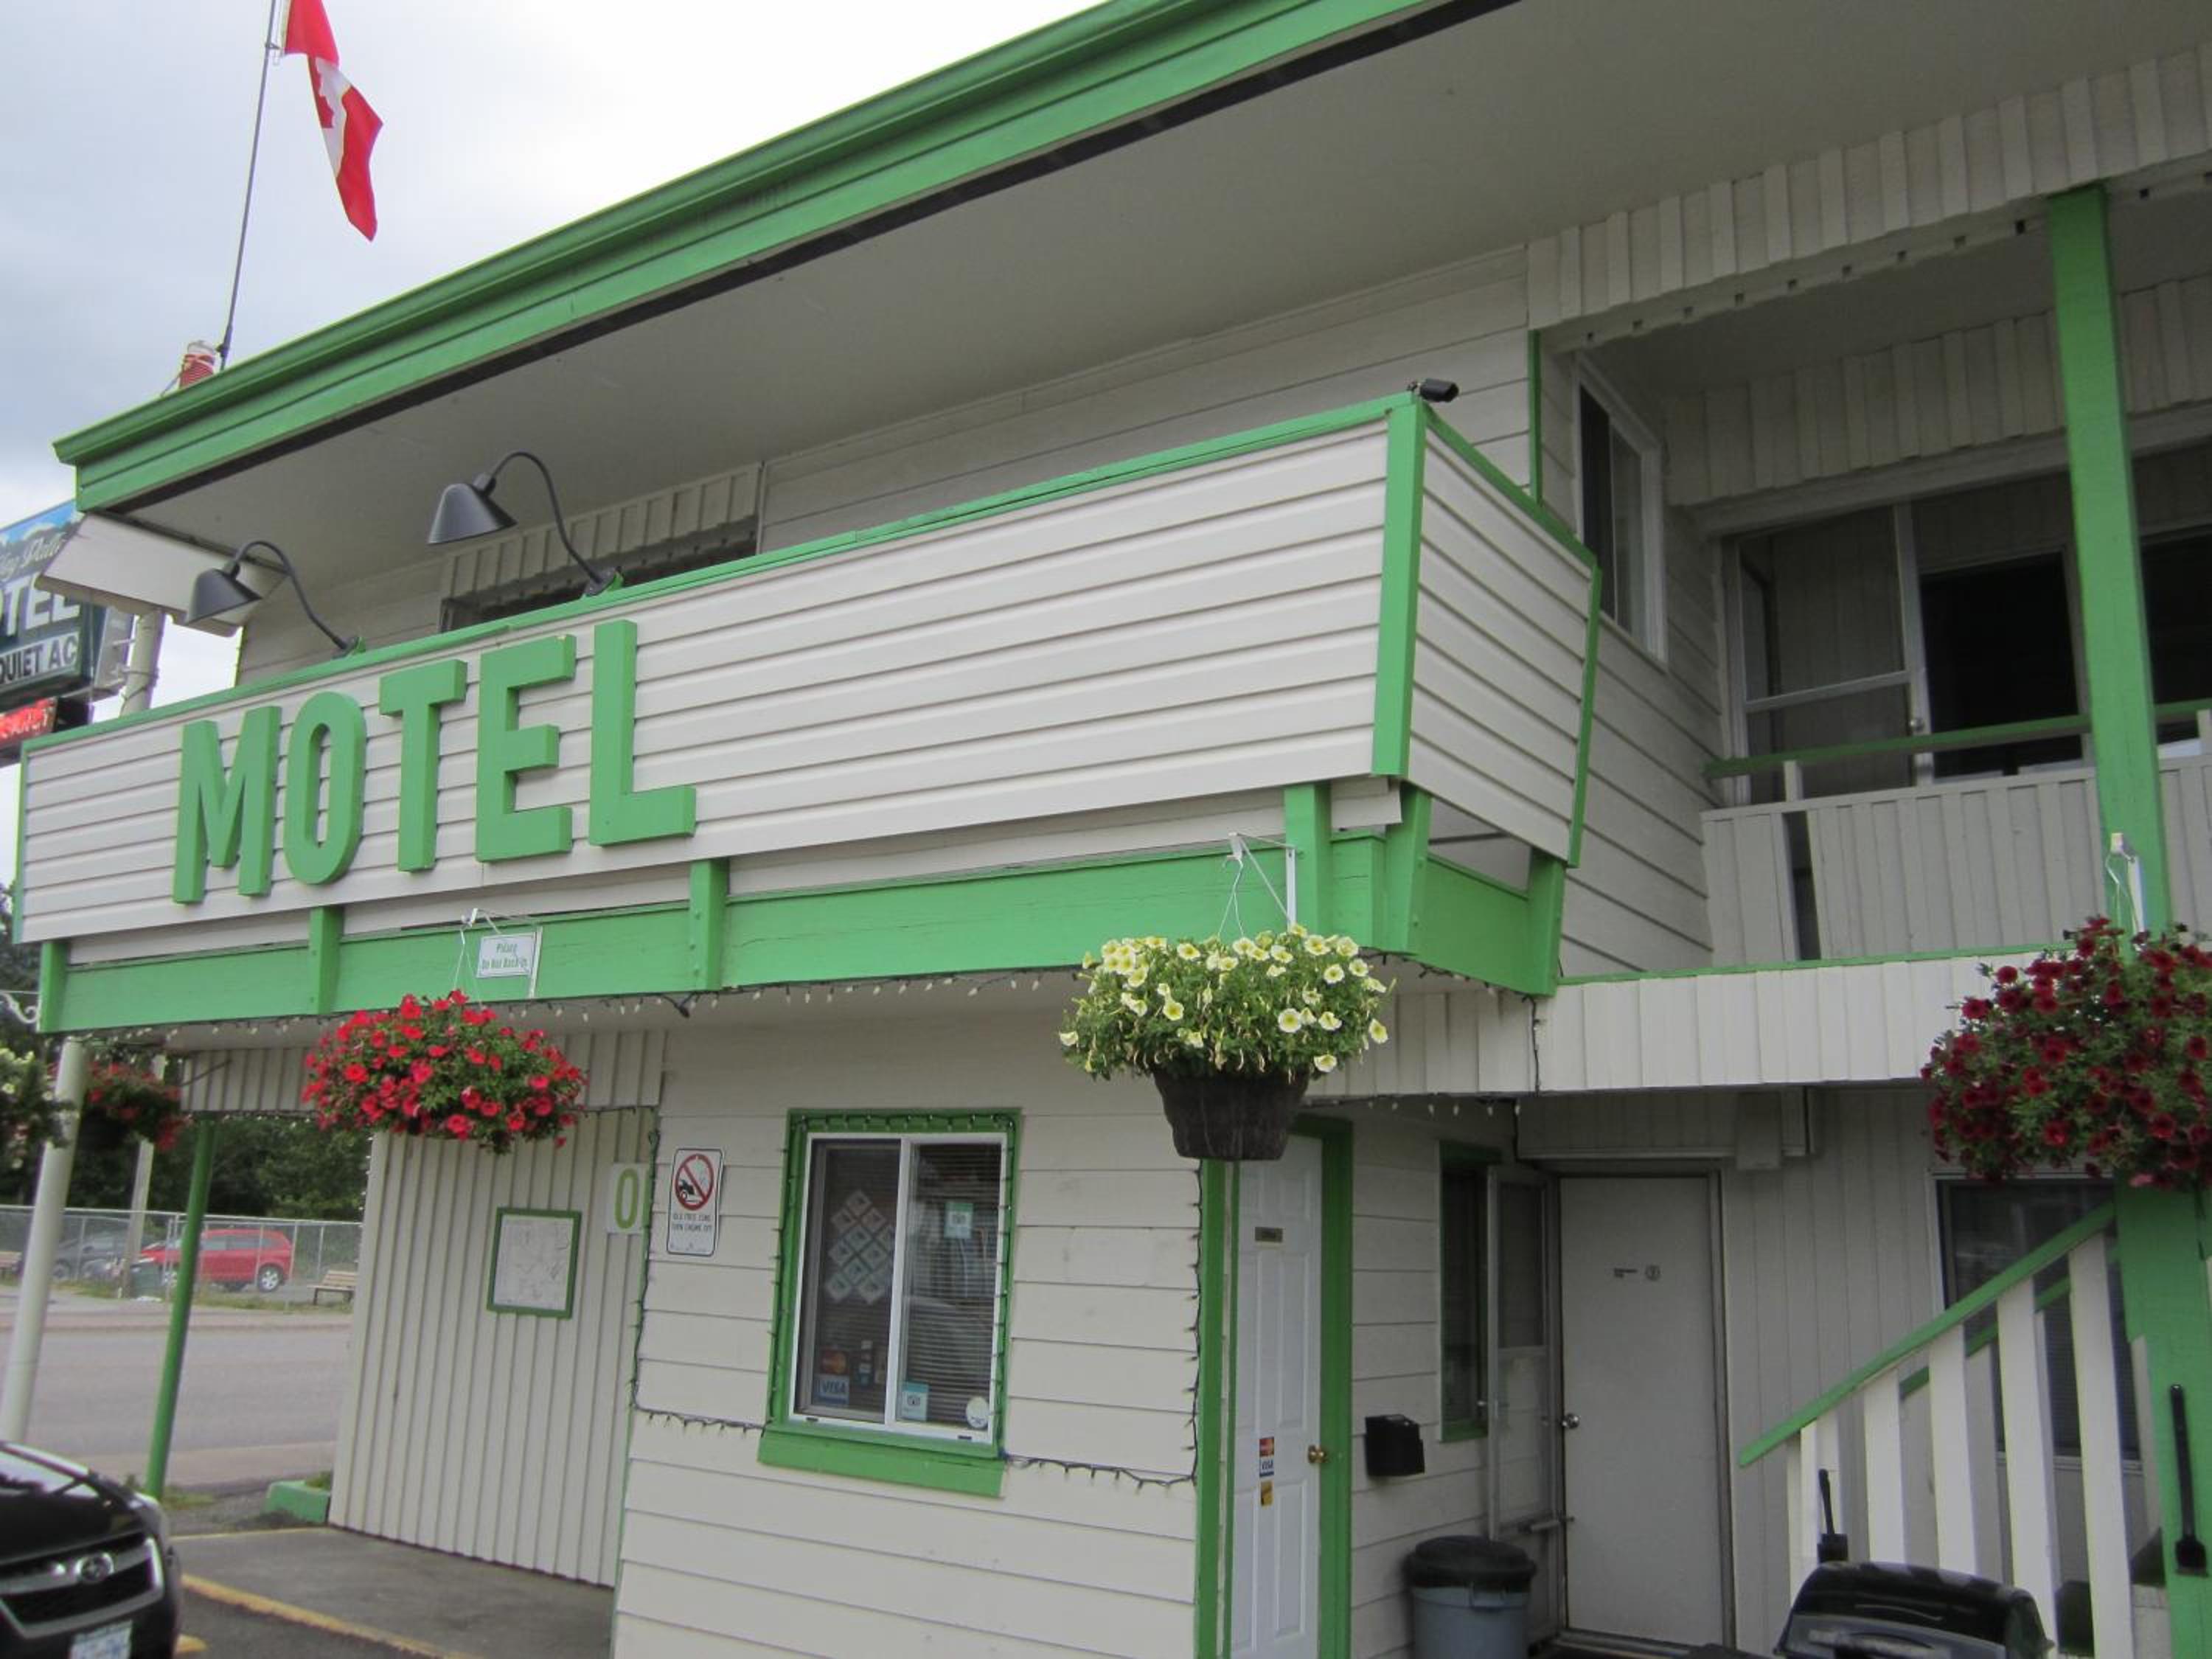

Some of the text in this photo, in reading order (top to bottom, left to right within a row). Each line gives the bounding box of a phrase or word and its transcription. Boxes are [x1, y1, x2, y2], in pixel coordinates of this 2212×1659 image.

[49, 636, 77, 668] AC
[172, 619, 696, 904] MOTEL
[822, 1380, 846, 1394] VISA
[1262, 1460, 1273, 1470] VISA
